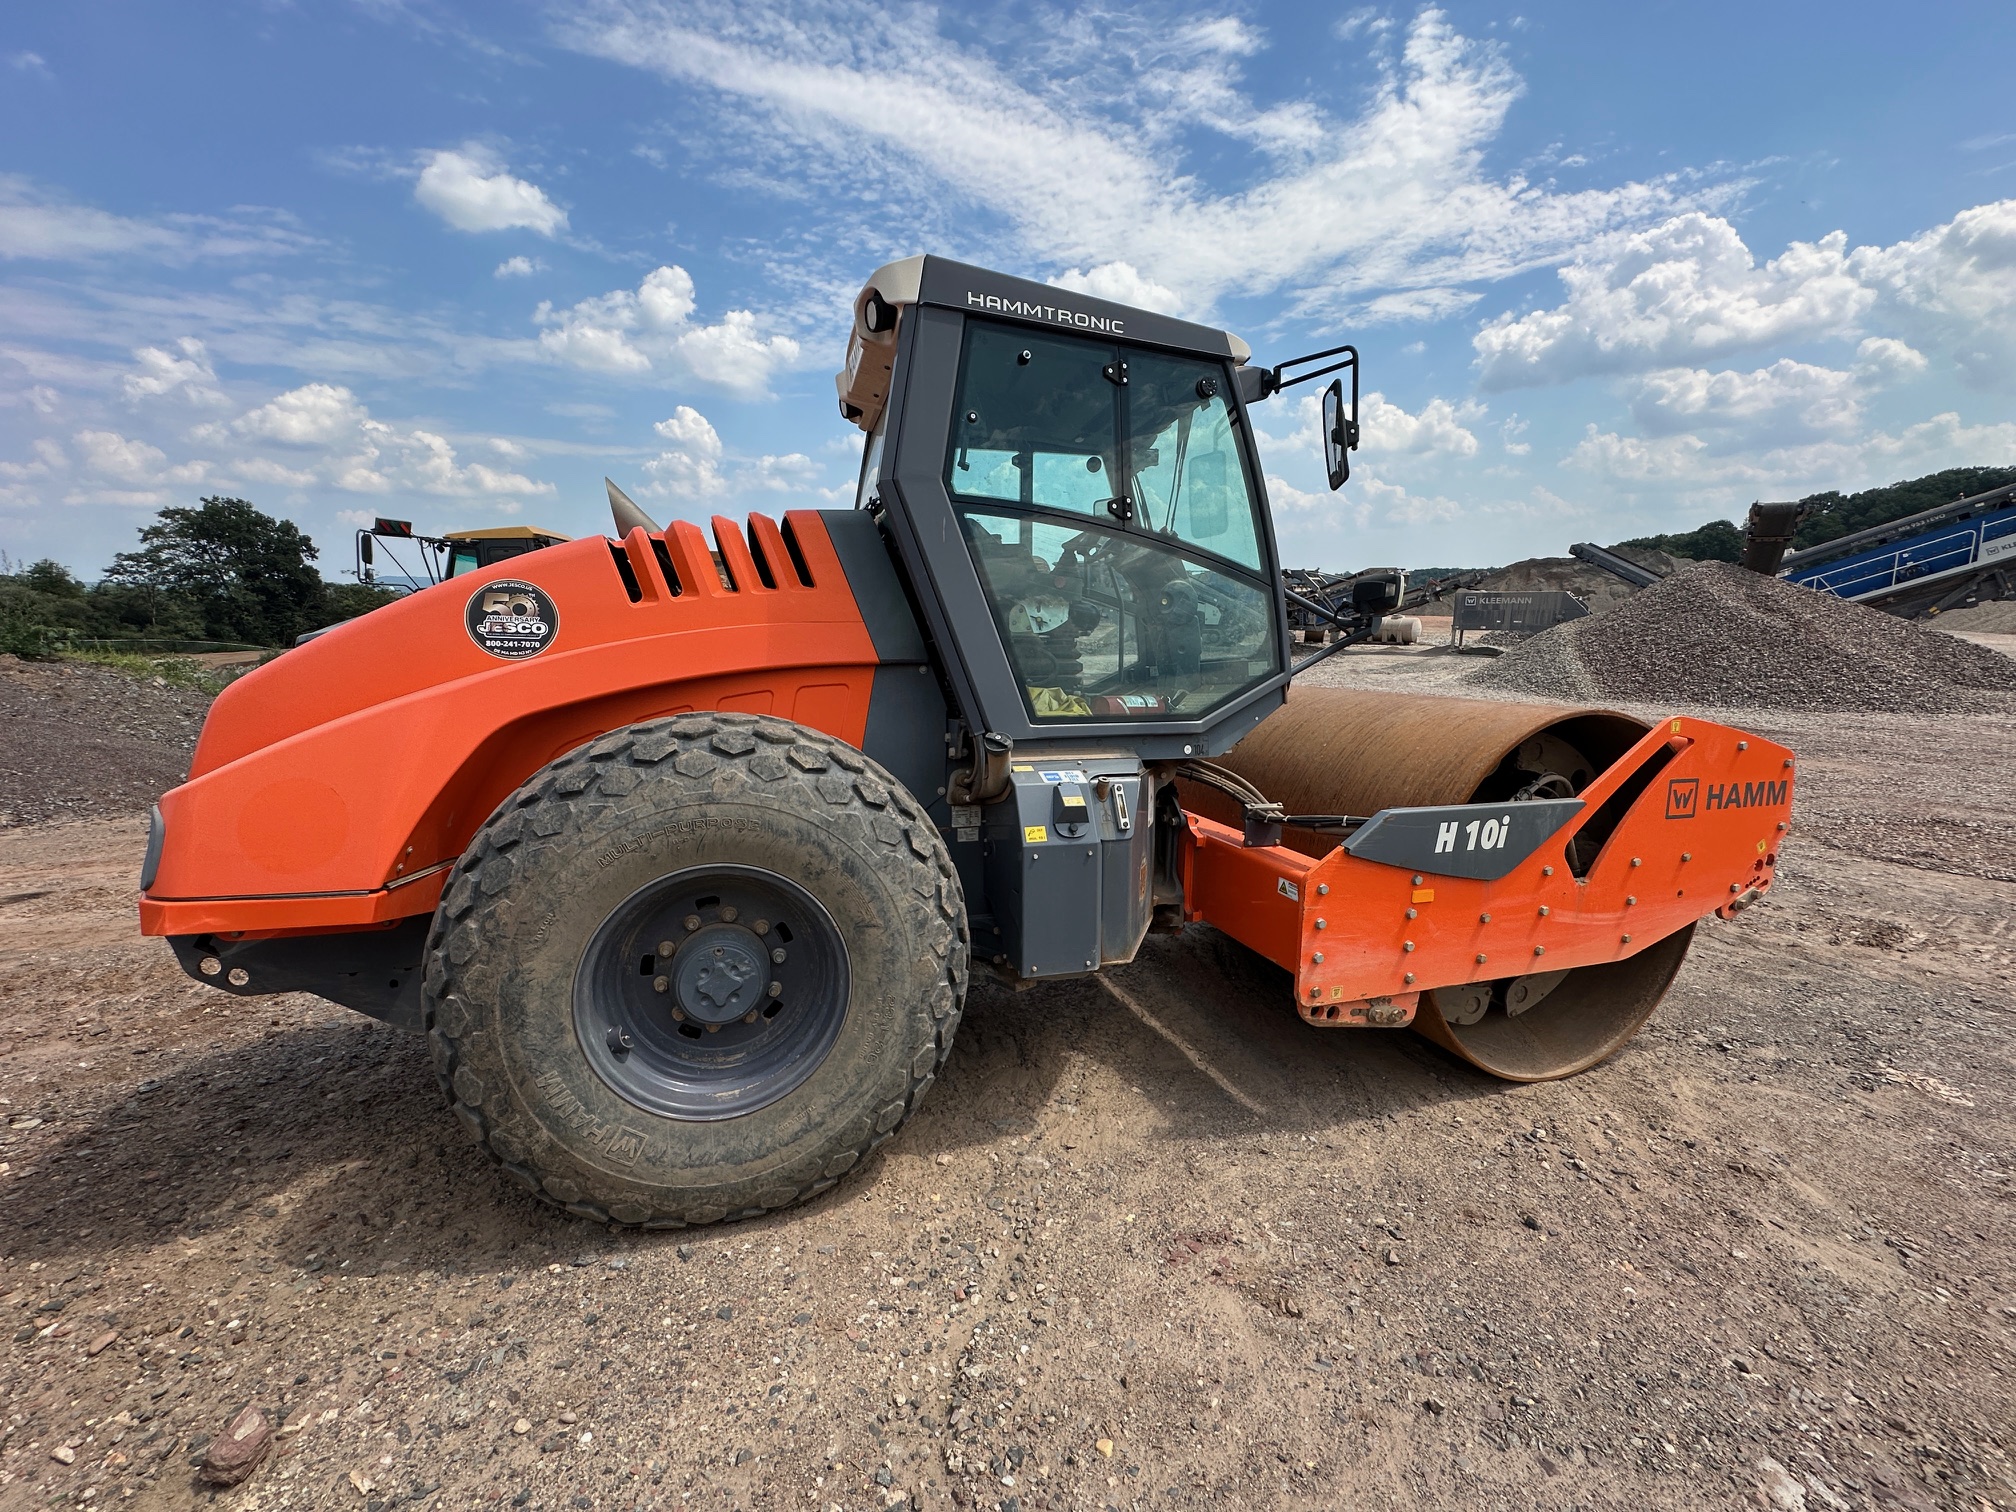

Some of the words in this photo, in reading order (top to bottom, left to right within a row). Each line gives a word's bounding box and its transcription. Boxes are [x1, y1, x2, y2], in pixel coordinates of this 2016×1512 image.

[967, 291, 1125, 334] HAMMTRONIC
[1479, 597, 1533, 605] KLEEMANN
[479, 621, 546, 634] JESCO
[486, 615, 540, 623] ANNIVERSARY
[485, 640, 541, 648] 800-241-7070
[1706, 780, 1788, 810] HAMM
[597, 817, 762, 868] MULTI-PURPOSE
[1434, 821, 1459, 854] H
[1465, 815, 1511, 851] 10i
[534, 1069, 612, 1146] HAMM
